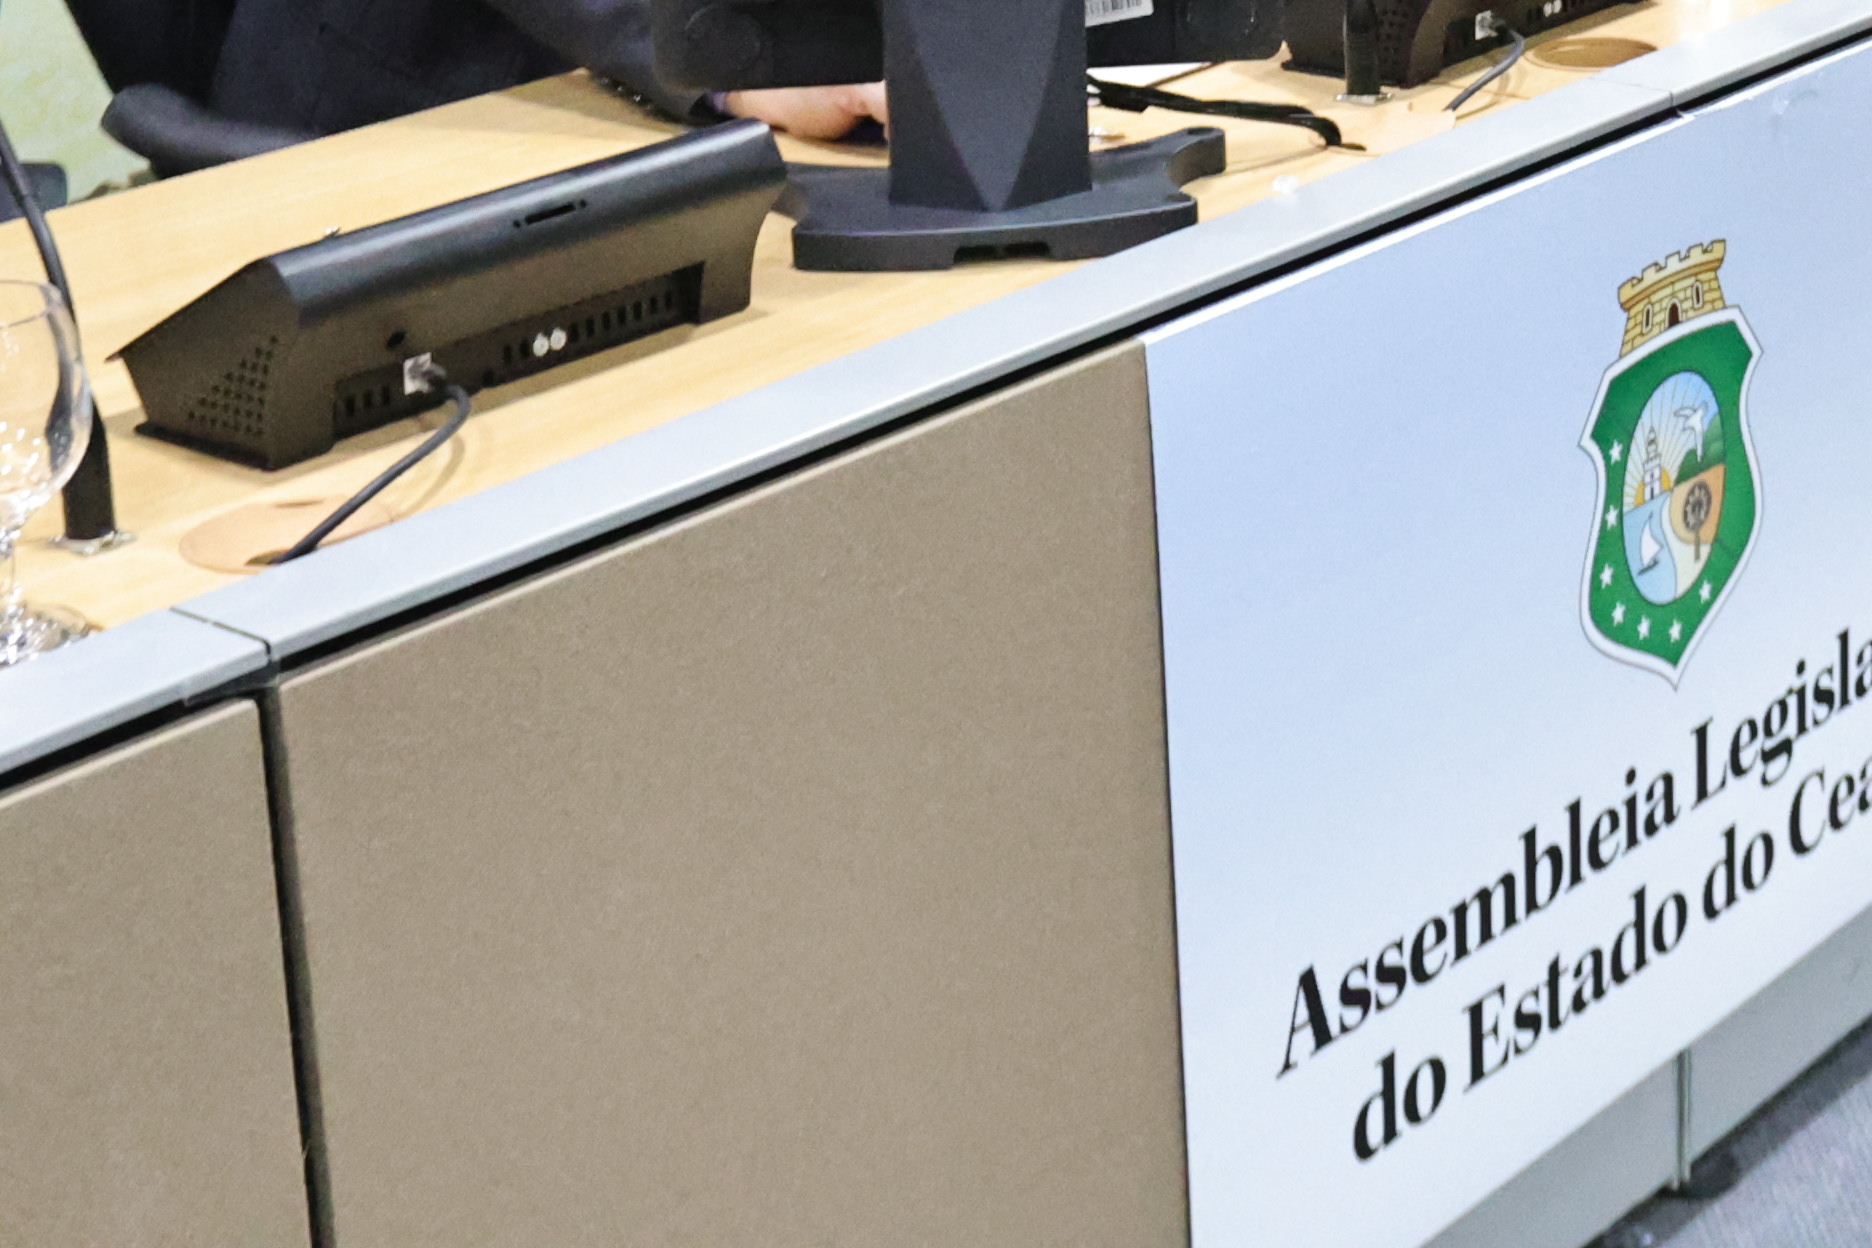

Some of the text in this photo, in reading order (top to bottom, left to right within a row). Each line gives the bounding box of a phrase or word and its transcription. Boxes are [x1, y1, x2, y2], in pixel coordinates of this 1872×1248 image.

[1276, 767, 1681, 1079] Assembleia
[1352, 1047, 1447, 1163] do
[1463, 884, 1689, 1094] Estado
[1701, 822, 1775, 923] do
